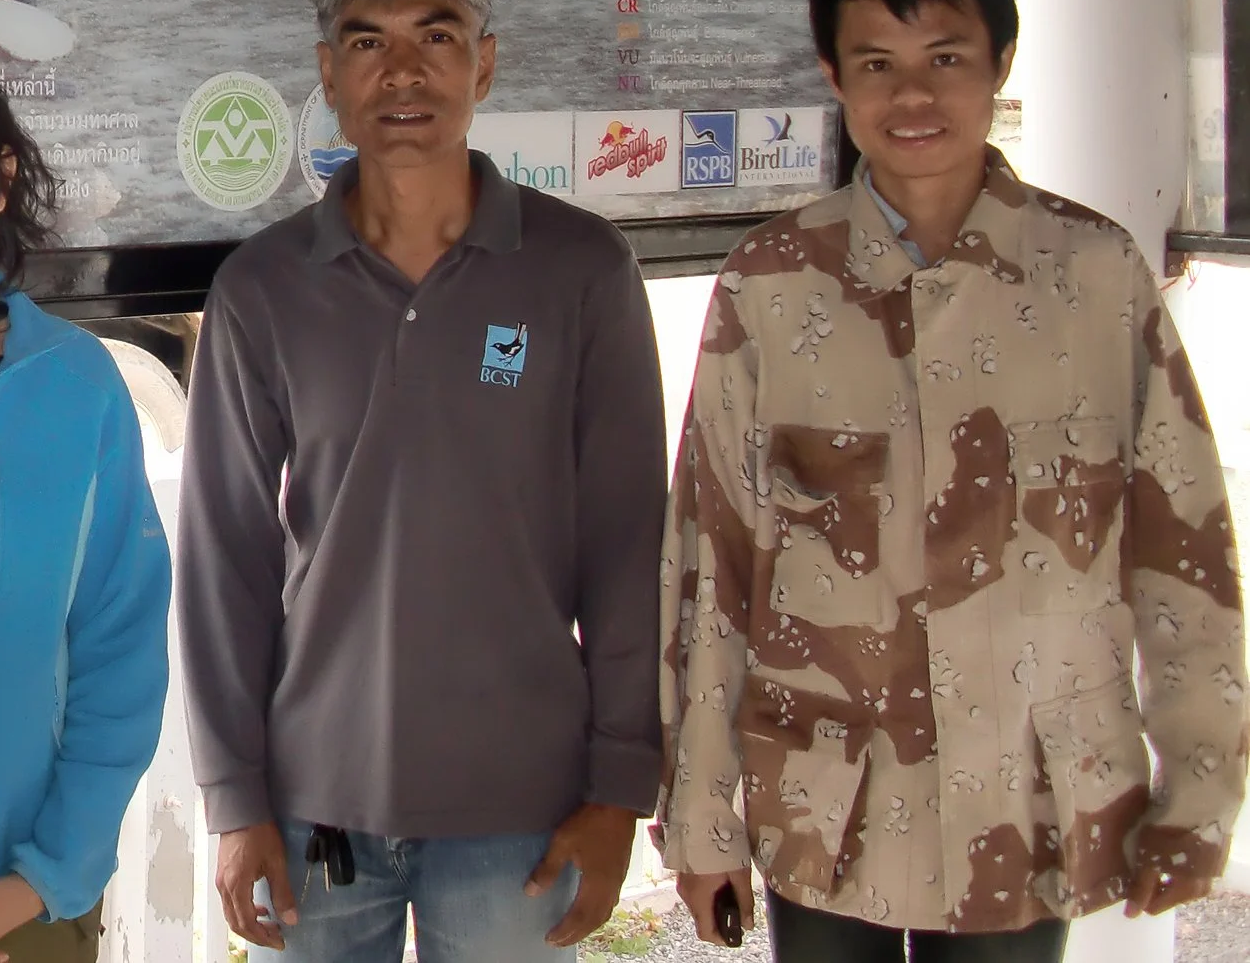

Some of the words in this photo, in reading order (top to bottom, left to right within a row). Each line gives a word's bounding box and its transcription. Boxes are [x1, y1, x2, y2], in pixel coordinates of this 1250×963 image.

[685, 154, 732, 182] RSPB
[739, 144, 817, 171] BirdLife
[480, 366, 522, 388] BCST
